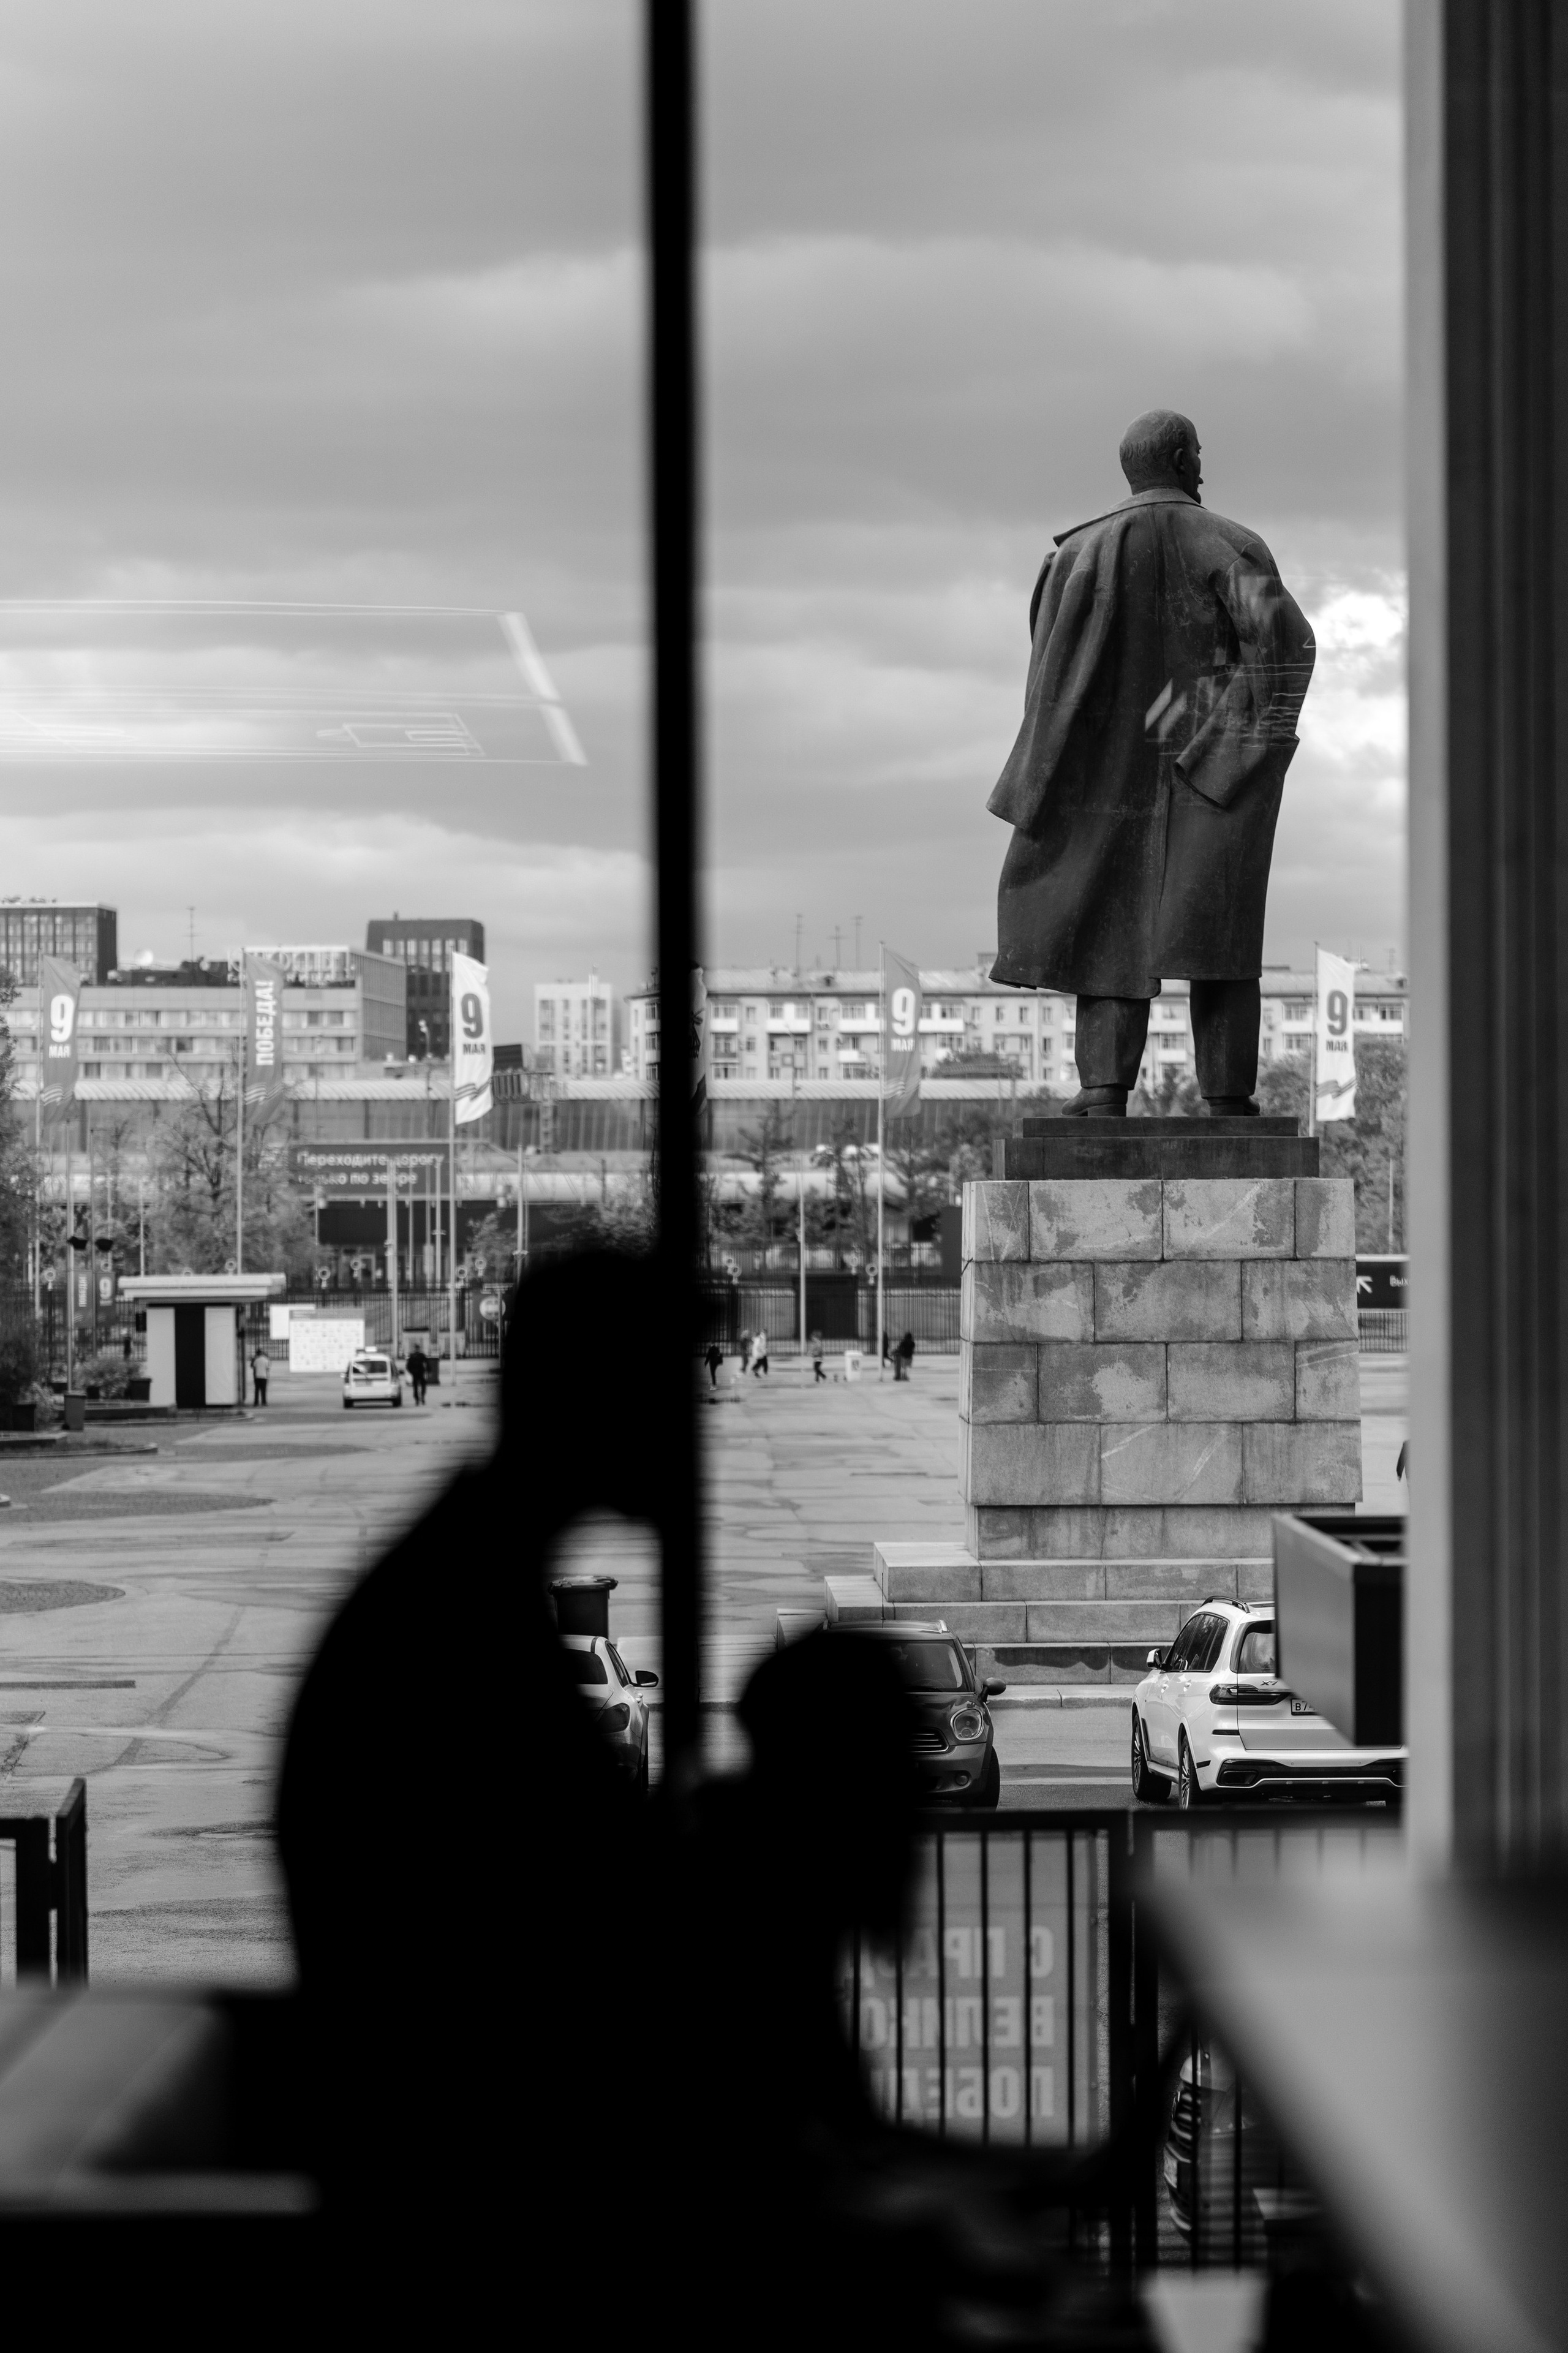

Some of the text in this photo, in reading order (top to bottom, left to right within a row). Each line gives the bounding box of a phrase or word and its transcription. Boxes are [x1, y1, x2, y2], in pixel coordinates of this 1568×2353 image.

[50, 994, 74, 1043] 9
[255, 980, 276, 1066] ПОБЕДА!
[461, 993, 484, 1039] 9
[892, 988, 915, 1037] 9
[1326, 990, 1348, 1035] 9
[49, 1044, 71, 1059] МАЯ
[462, 1043, 486, 1055] МАЯ
[1326, 1040, 1348, 1052] МАЯ
[350, 1173, 369, 1185] по
[372, 1171, 418, 1187] зере
[99, 1277, 111, 1299] 9
